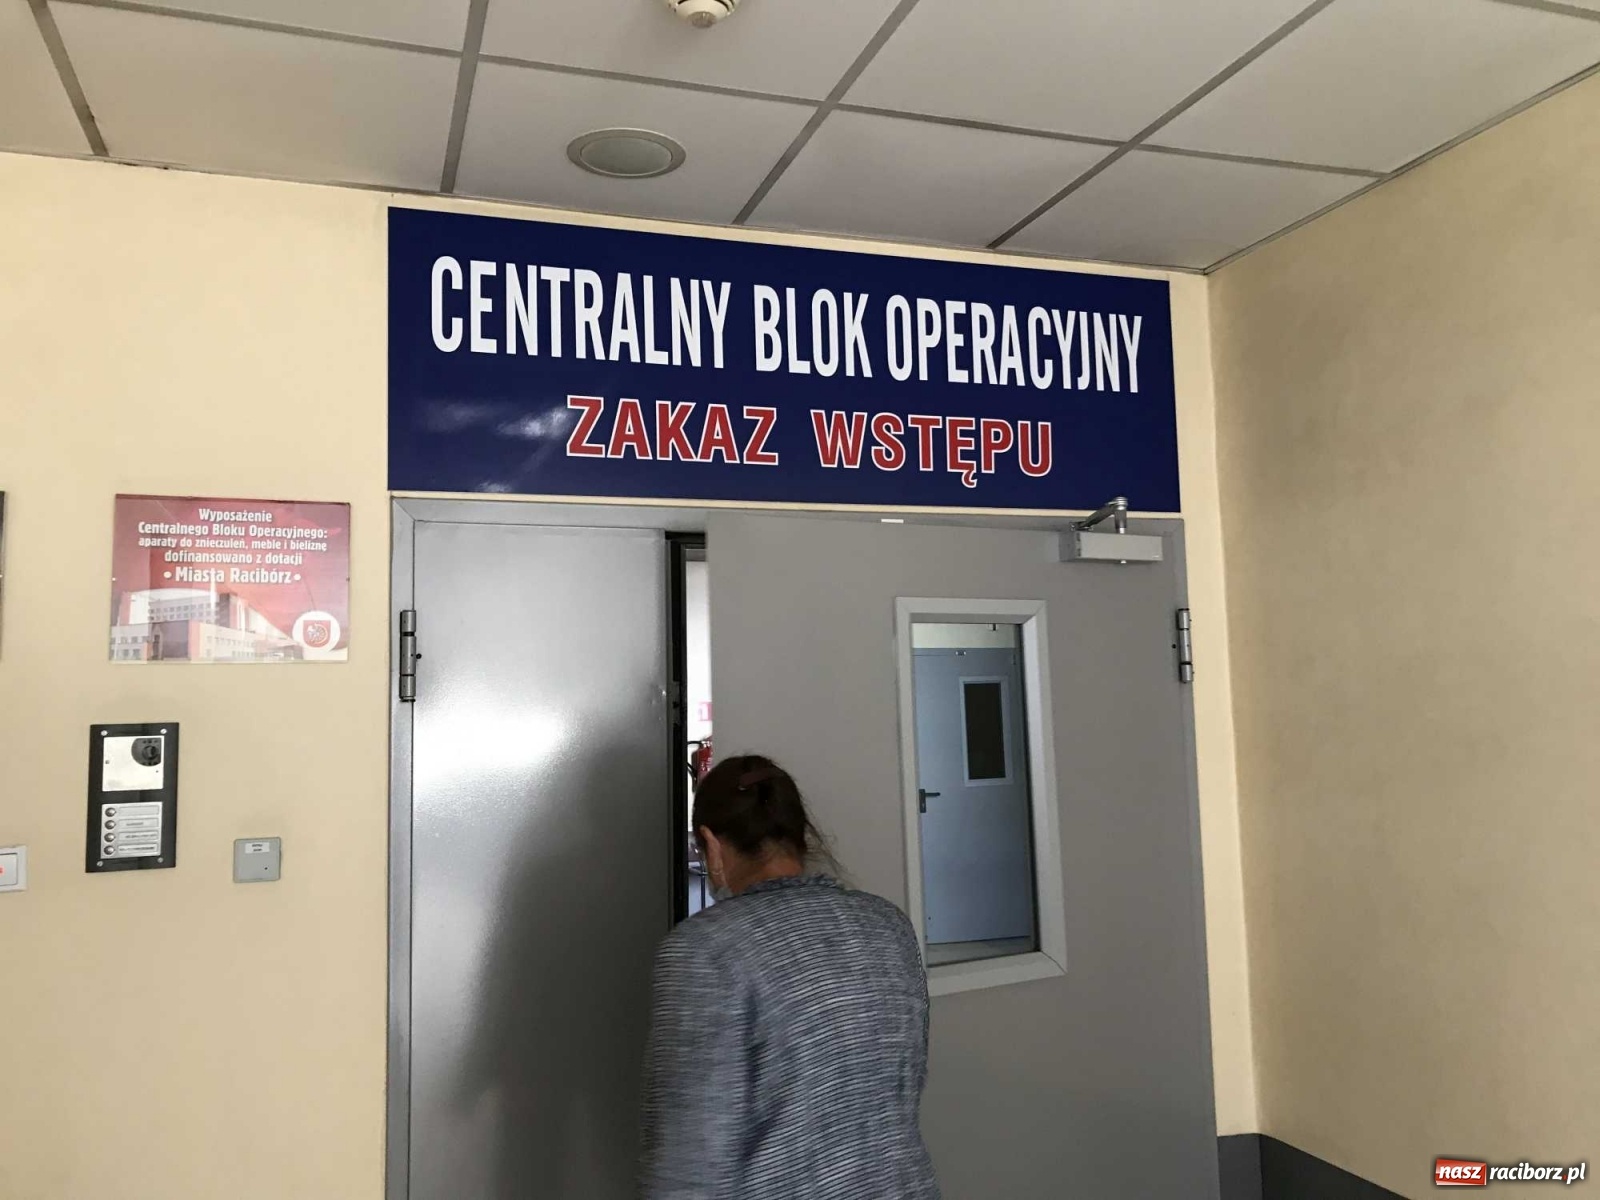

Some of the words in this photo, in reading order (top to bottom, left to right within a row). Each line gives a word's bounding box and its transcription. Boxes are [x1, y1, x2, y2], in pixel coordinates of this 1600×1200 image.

[430, 255, 731, 369] CENTRALNY
[754, 284, 872, 378] BLOK
[885, 294, 1142, 393] OPERACYJNY
[565, 394, 779, 466] ZAKAZ
[811, 409, 1053, 489] WSTĘPU
[198, 508, 272, 523] Wyposażenie
[138, 522, 208, 536] Centralnego
[212, 523, 245, 537] Bloku
[249, 525, 328, 539] Operacyjnego:
[138, 537, 177, 548] aparaty
[180, 538, 192, 548] do
[195, 538, 248, 549] znieczuleń,
[251, 540, 281, 549] meble
[283, 540, 287, 550] i
[290, 541, 327, 551] bieliznę
[164, 550, 252, 564] dofinansowano
[256, 555, 261, 564] z
[265, 552, 303, 566] dotacji
[175, 567, 224, 583] Miasta
[230, 568, 292, 584] Racibórz
